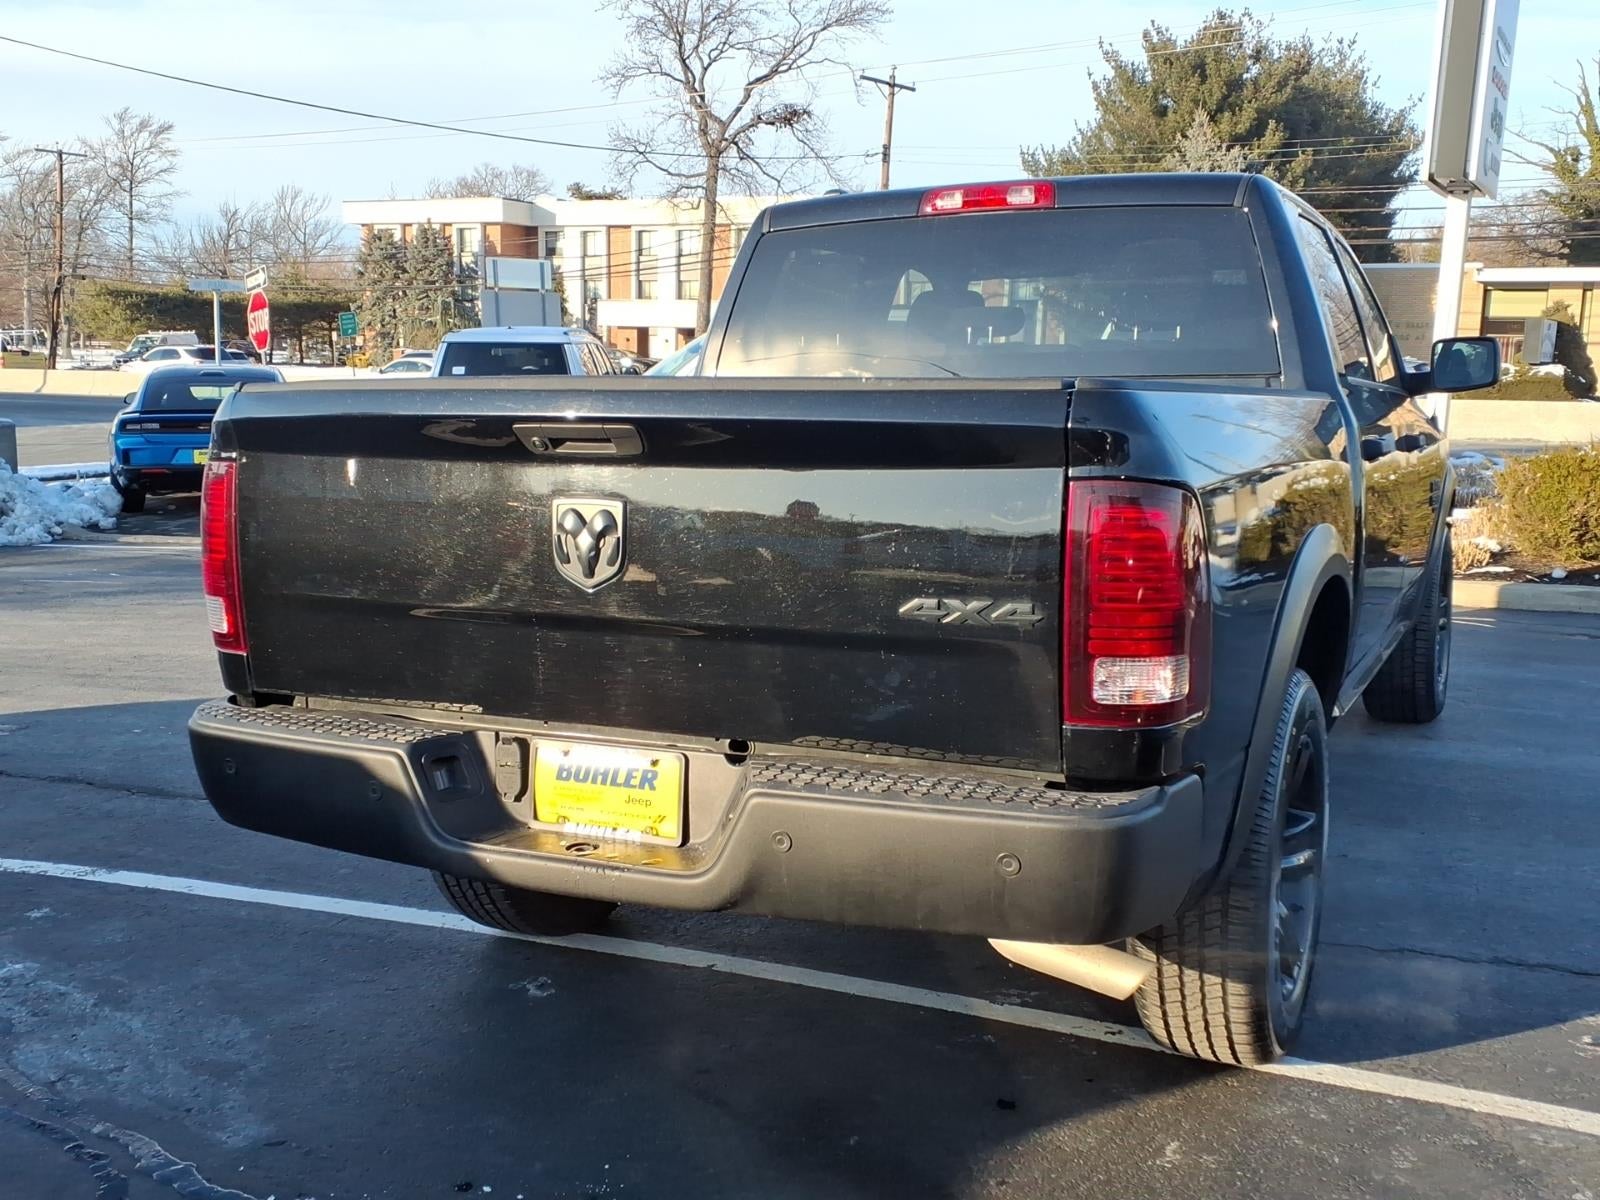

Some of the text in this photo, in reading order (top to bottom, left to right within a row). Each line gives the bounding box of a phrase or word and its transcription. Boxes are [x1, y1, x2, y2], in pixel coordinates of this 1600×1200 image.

[250, 308, 269, 334] STOP
[555, 761, 659, 792] BUHLER
[624, 794, 652, 808] Jeep
